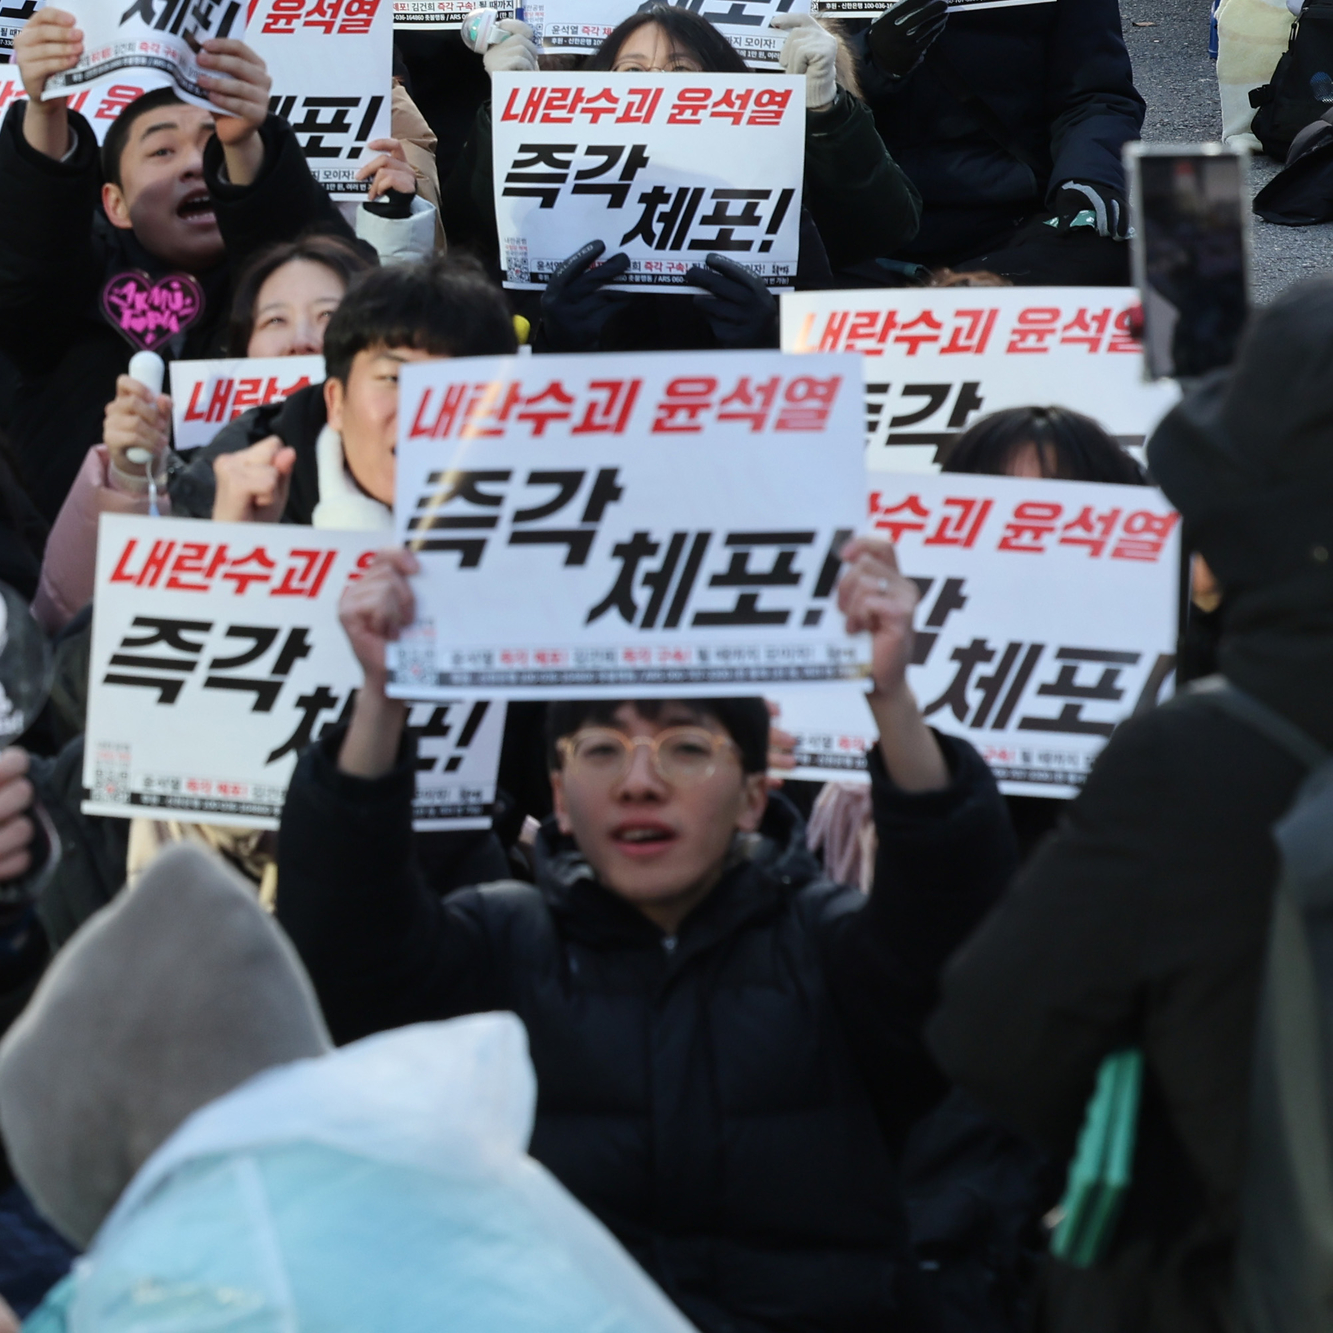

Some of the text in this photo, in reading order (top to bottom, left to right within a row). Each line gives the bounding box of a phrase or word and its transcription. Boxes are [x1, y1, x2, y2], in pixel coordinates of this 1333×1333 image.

[502, 88, 792, 125] 내란수괴 윤석열
[502, 144, 795, 252] 즉각 체포!
[410, 377, 841, 438] 내란수괴 윤석열
[405, 468, 852, 629] 즉각 체포!
